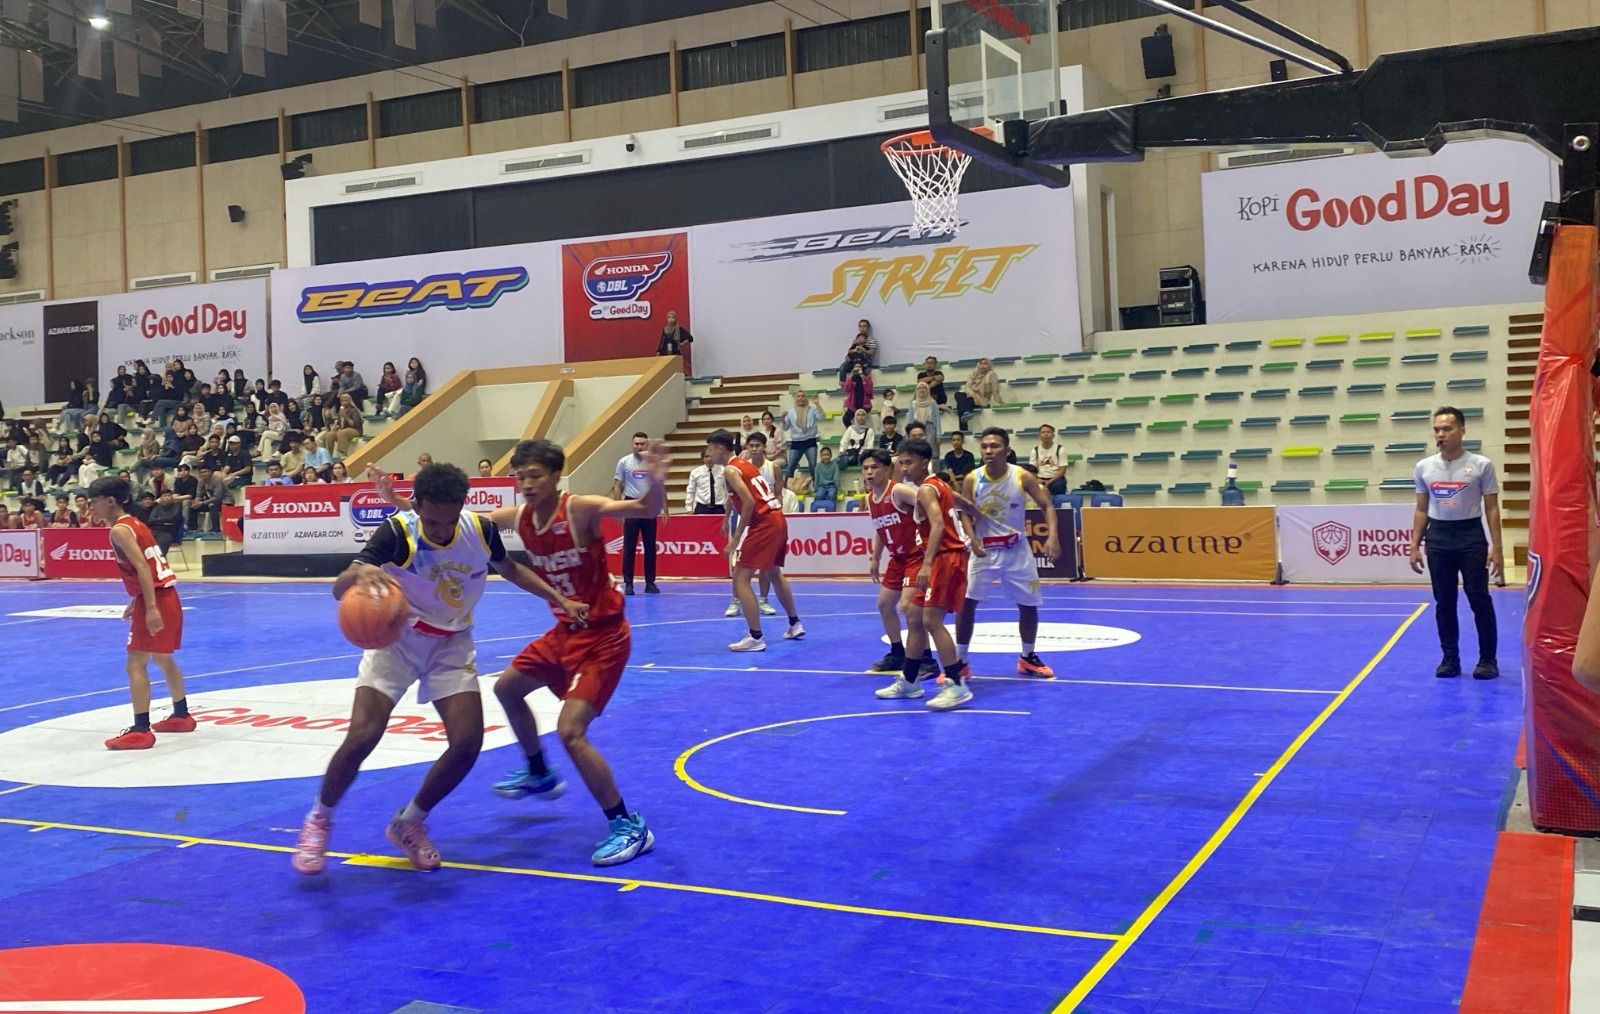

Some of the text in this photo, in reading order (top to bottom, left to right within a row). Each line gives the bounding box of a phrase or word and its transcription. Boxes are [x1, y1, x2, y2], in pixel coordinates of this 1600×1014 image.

[1286, 179, 1408, 232] Good
[1414, 174, 1511, 226] Day
[1252, 242, 1492, 274] KARENA HIDUP PERLU BANYAK RASA
[606, 264, 651, 275] HONDA
[794, 243, 1042, 308] STREET
[606, 280, 629, 292] DBL
[141, 305, 199, 339] Good
[202, 303, 247, 339] Day
[47, 324, 95, 336] AZAWEAR.COM
[193, 351, 218, 361] BANYAK
[222, 350, 237, 359] RASA
[271, 501, 337, 514] HONDA
[367, 509, 384, 519] DBL
[294, 530, 344, 539] AZAWEAR.COM
[884, 528, 894, 545] 1
[784, 531, 833, 557] ood
[1034, 556, 1056, 569] ILK
